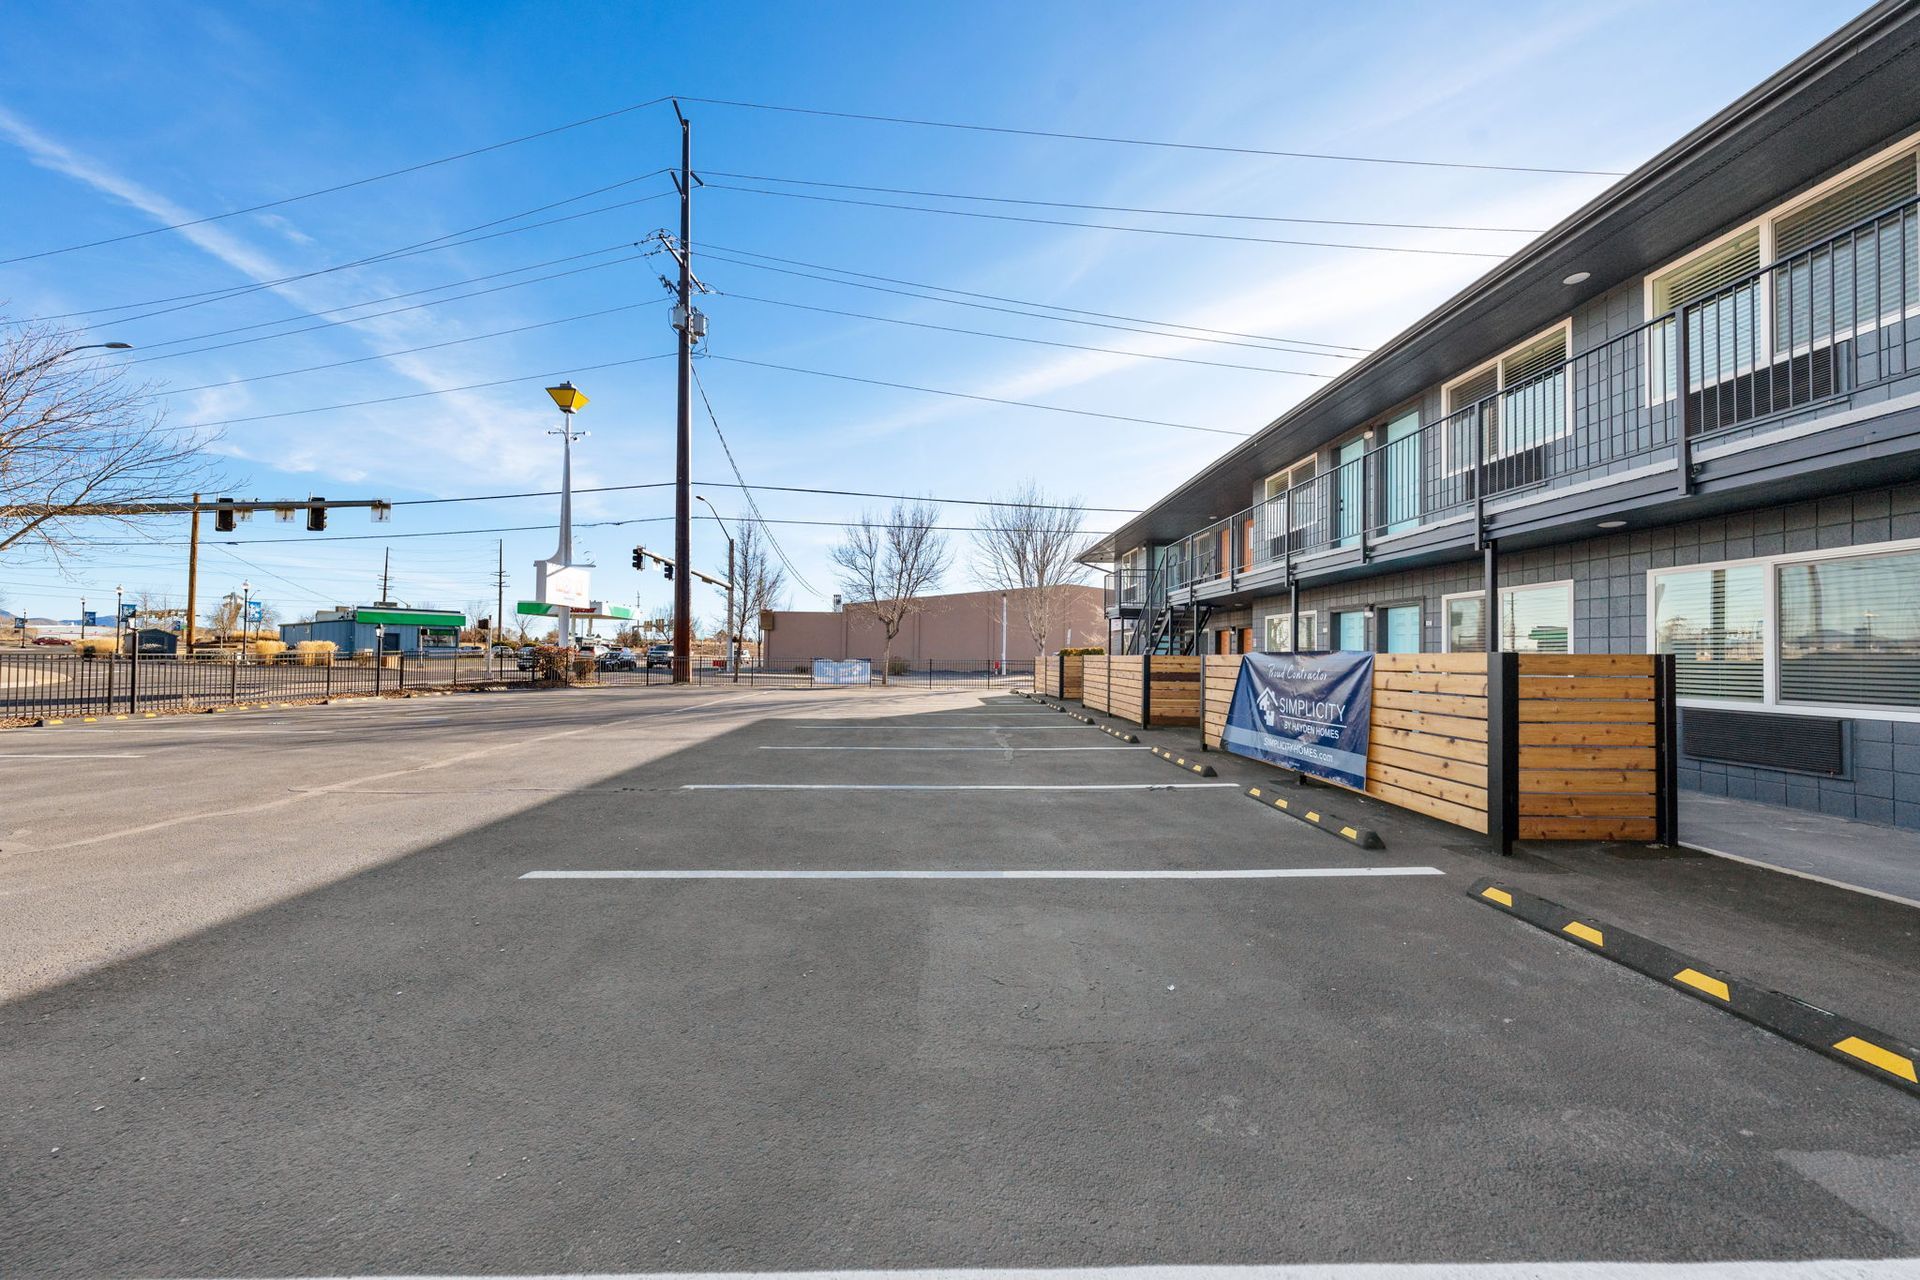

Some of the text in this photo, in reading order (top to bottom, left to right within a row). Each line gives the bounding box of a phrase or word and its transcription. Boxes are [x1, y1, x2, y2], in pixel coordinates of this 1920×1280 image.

[1267, 663, 1328, 681] Proud Contractor
[1279, 697, 1346, 723] SIMPLICITY
[1283, 721, 1340, 740] BY HAYDEN HOMES
